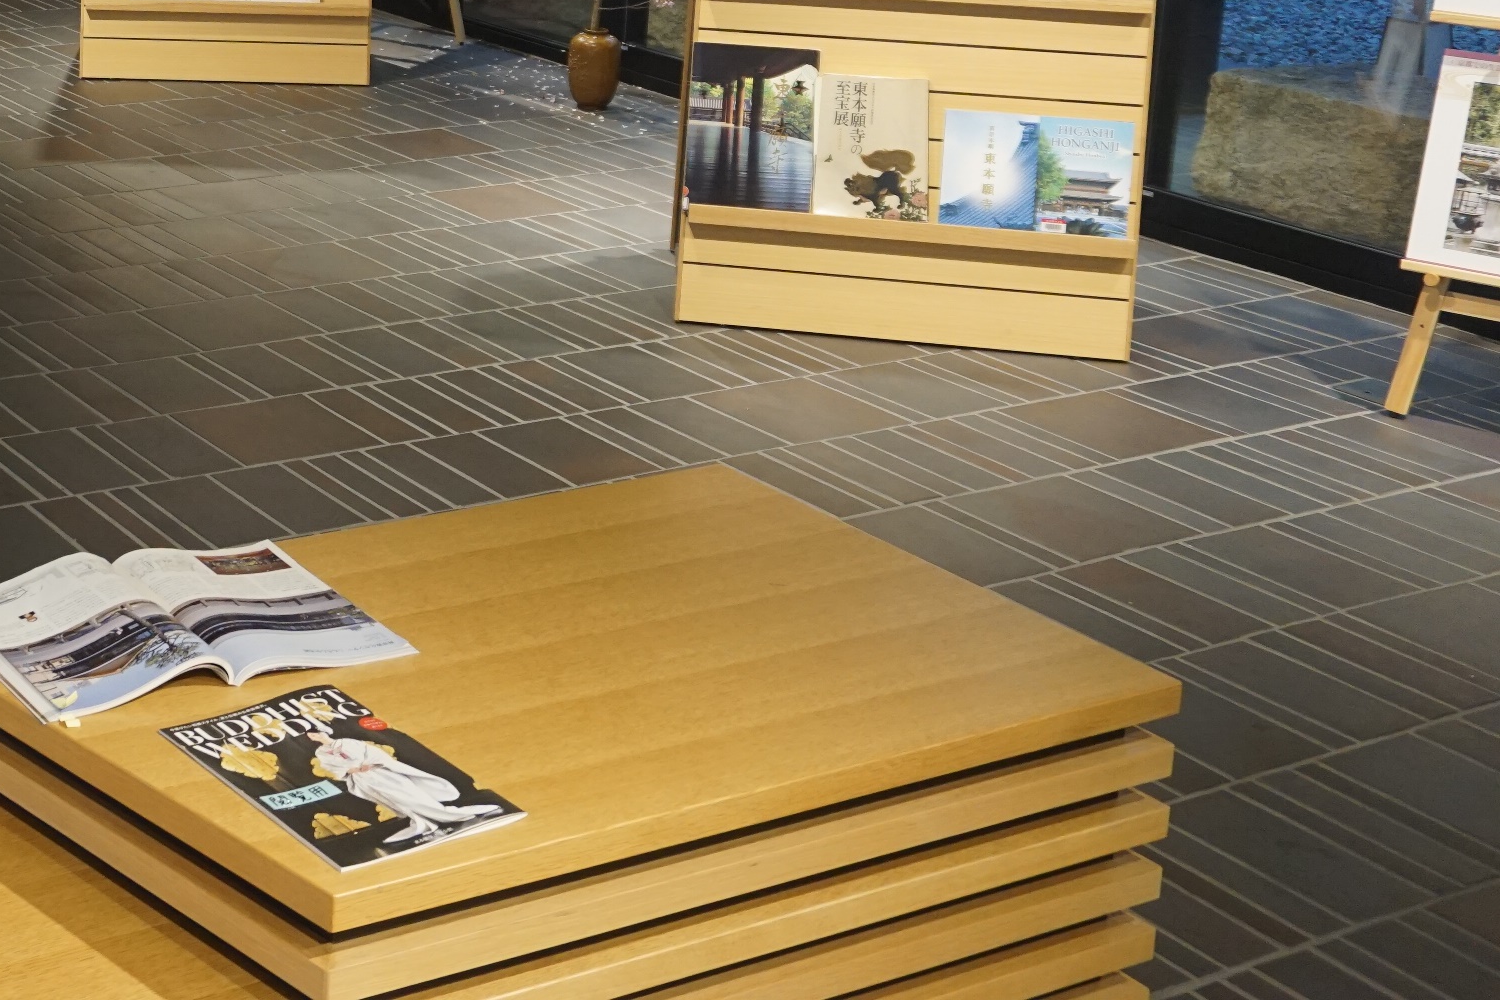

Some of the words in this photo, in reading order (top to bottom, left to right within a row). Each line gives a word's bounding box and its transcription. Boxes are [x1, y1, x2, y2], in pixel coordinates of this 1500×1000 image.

[834, 79, 851, 127] 至宝展
[849, 81, 869, 155] 東本願寺の
[1051, 137, 1120, 154] HONGANJI
[1058, 125, 1115, 139] HIGASHI
[980, 152, 997, 211] 東本願寺
[173, 688, 348, 747] BUDDHIST
[192, 701, 372, 760] WEDDING
[268, 785, 330, 806] 閲覧用
